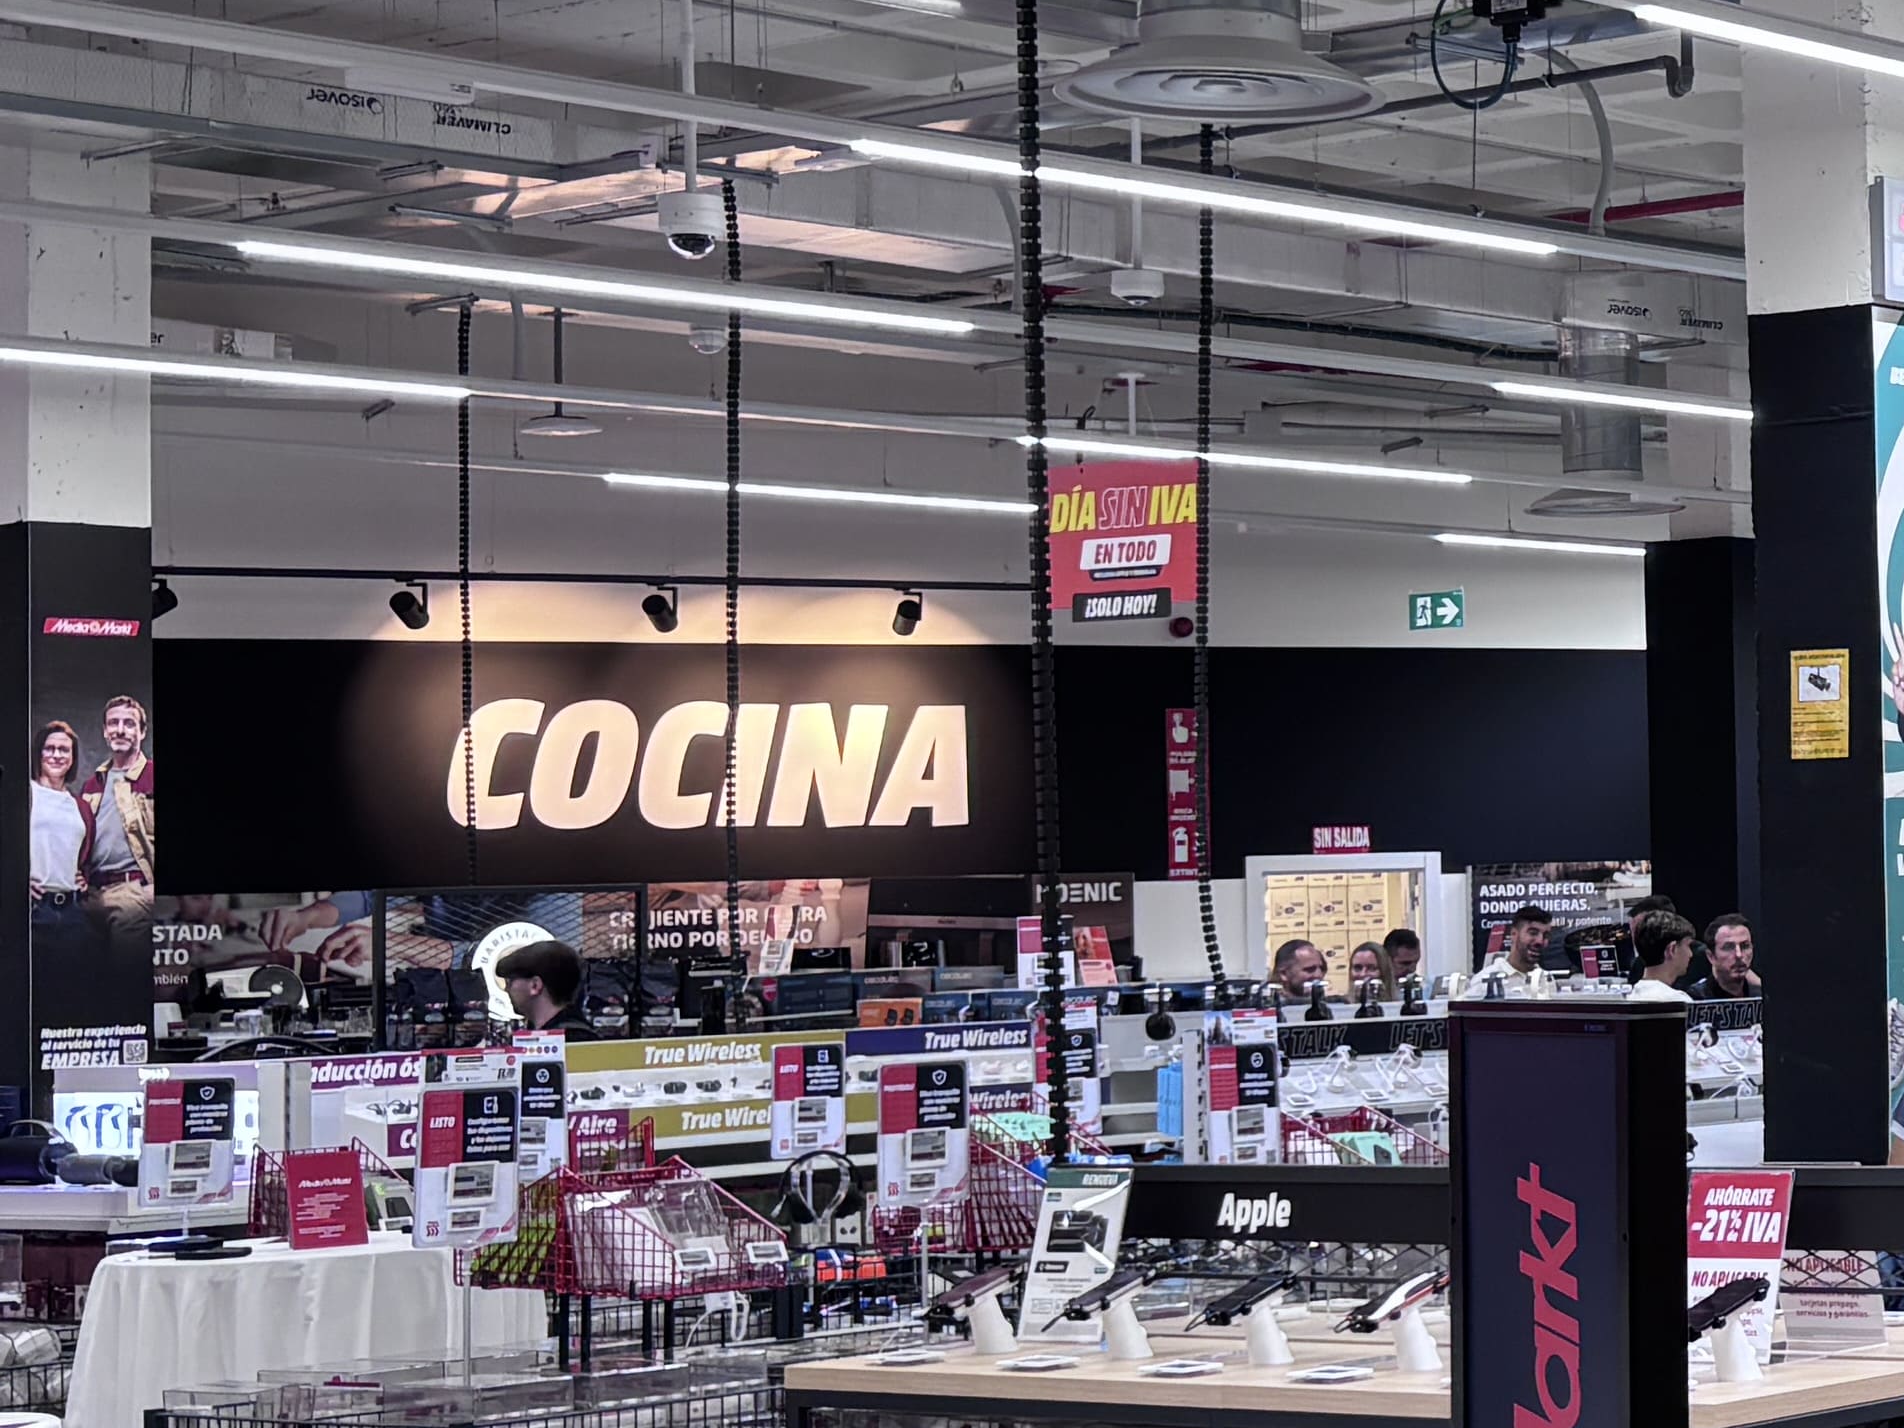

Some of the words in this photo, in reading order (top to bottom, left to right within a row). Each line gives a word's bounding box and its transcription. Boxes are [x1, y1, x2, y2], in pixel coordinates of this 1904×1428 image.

[1050, 484, 1096, 533] DÍA
[1098, 486, 1148, 530] SIN
[1149, 483, 1197, 525] IVA
[1094, 543, 1114, 564] EN
[1118, 540, 1157, 563] TODO
[1085, 596, 1121, 618] ¡SOLO
[1123, 594, 1157, 615] HOY!
[446, 697, 970, 830] COCINA
[1313, 827, 1336, 849] SIN
[1338, 825, 1371, 848] SALIDA
[1479, 884, 1525, 898] ASADO
[1528, 882, 1599, 898] PERFECTO,
[1480, 901, 1526, 914] DONDE
[609, 909, 712, 929] CRJIENTE
[152, 925, 222, 943] STADA
[689, 930, 730, 948] POR
[924, 1031, 960, 1050] True
[962, 1028, 1028, 1048] Wireless
[41, 1050, 120, 1070] EMPRESA
[644, 1044, 686, 1065] True
[687, 1041, 761, 1064] Wireless
[430, 1117, 455, 1129] LISTO
[576, 1113, 617, 1140] Aire
[680, 1109, 722, 1131] True
[1704, 1185, 1775, 1206] AHÓRRATE
[1217, 1191, 1292, 1236] Apple
[1741, 1212, 1782, 1244] IVA
[1691, 1270, 1708, 1287] NO
[1709, 1270, 1769, 1287] APLIC
